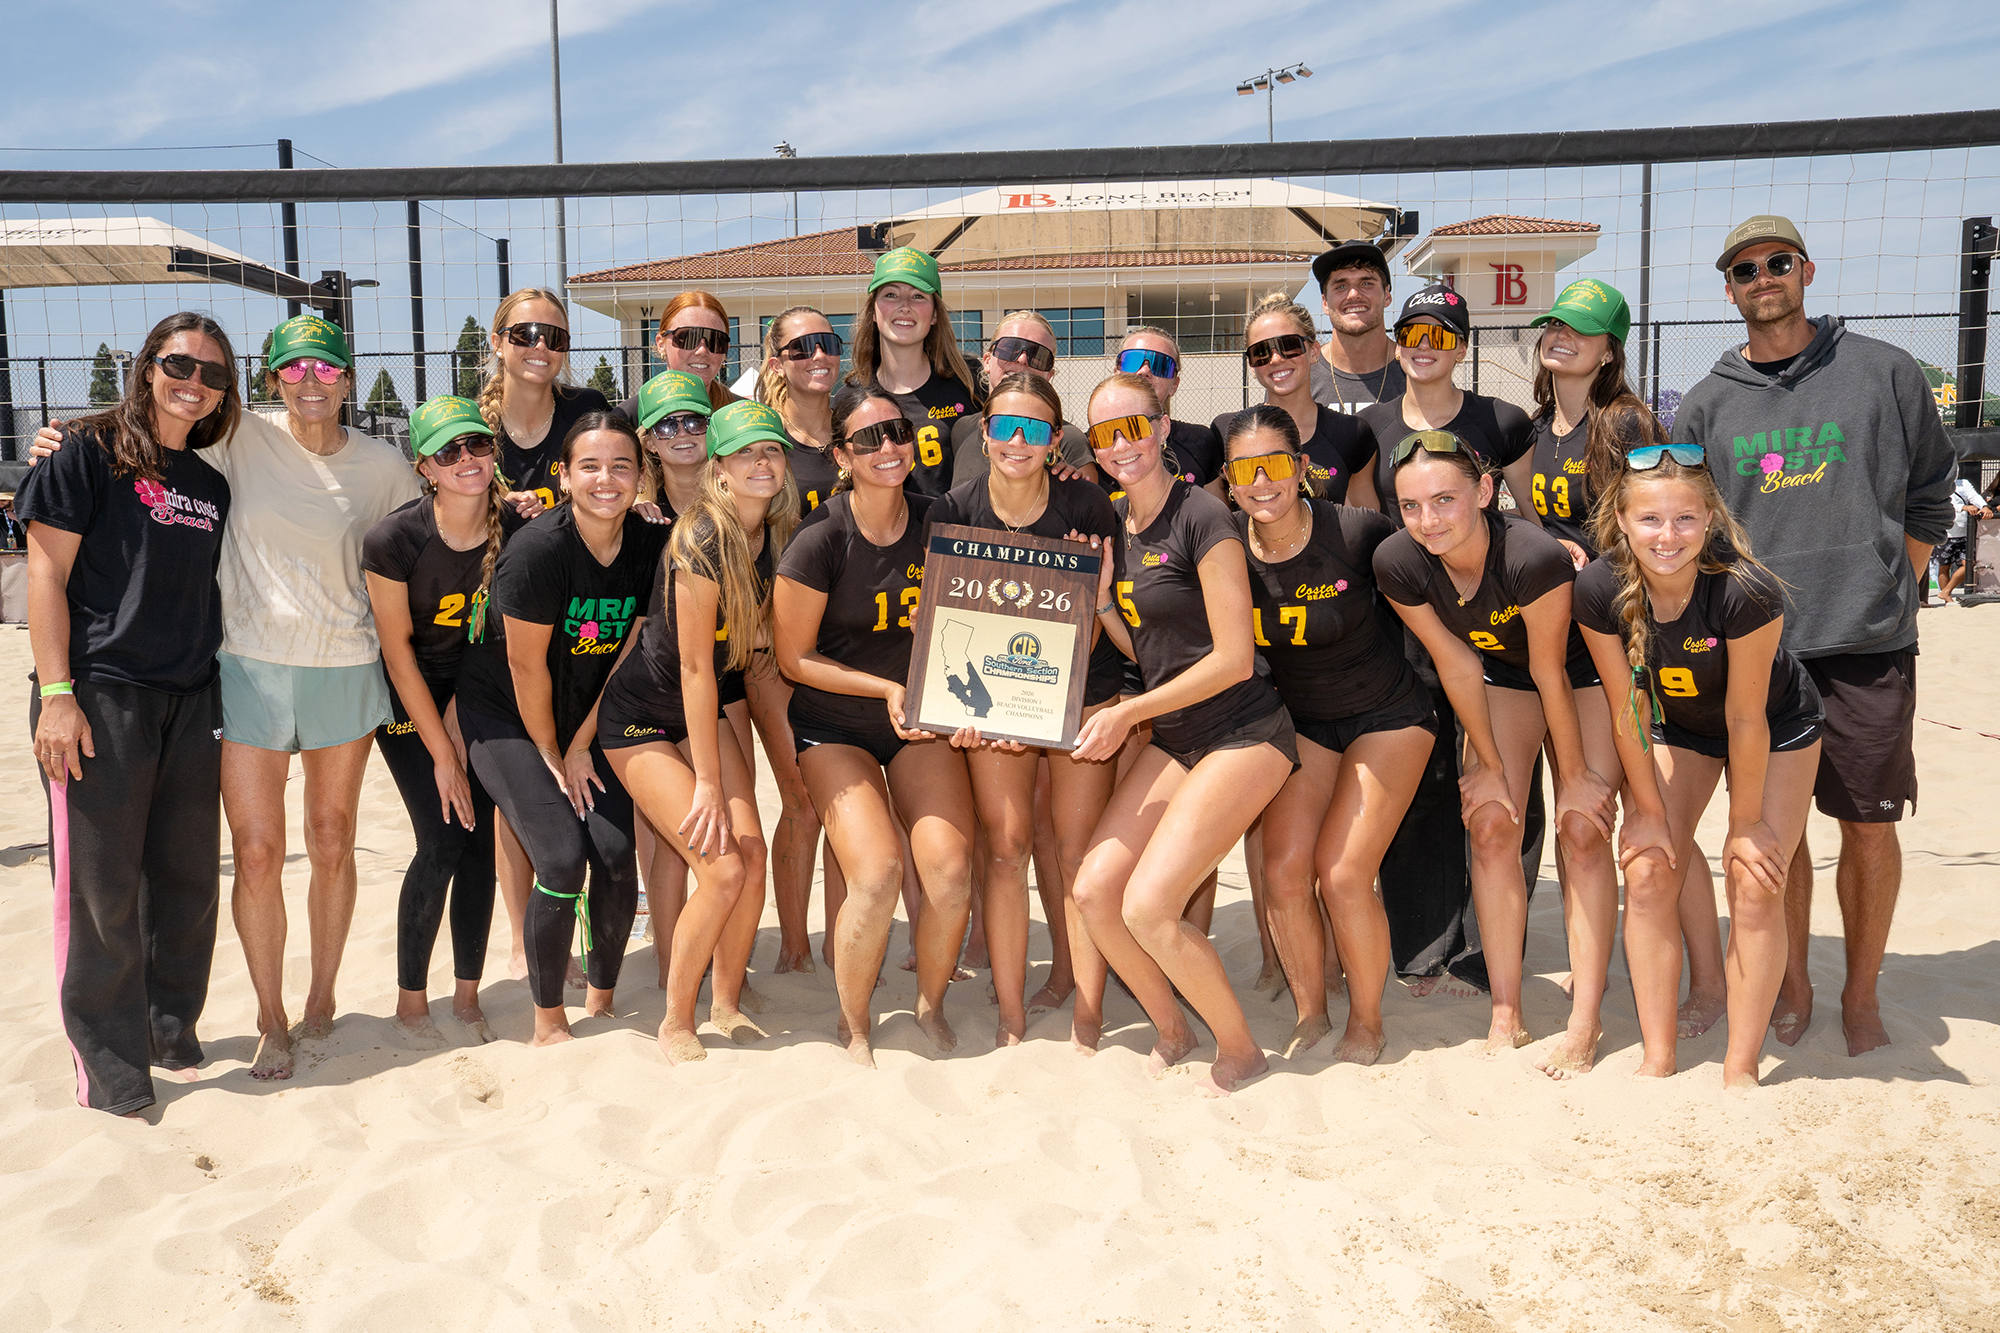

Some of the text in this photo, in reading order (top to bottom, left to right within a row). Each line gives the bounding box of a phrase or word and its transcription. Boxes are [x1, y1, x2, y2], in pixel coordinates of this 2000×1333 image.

[1160, 191, 1250, 199] BEACH
[1408, 291, 1447, 308] Costa
[928, 405, 956, 419] Costa
[1732, 421, 1846, 458] MIRA
[1760, 461, 1828, 494] Beach
[163, 487, 219, 521] mira costa
[1532, 472, 1572, 518] 63
[150, 501, 214, 532] Beach
[952, 540, 1079, 569] CHAMPIONS
[1295, 583, 1336, 599] Costa
[1306, 590, 1339, 601] BEACH
[873, 586, 922, 632] 13
[1490, 604, 1520, 626] Costa
[1252, 605, 1308, 647] 17
[1012, 636, 1037, 657] CIF
[1468, 630, 1506, 651] 2
[985, 656, 1023, 673] Southern
[1026, 666, 1058, 675] Section
[1012, 656, 1034, 667] Ford
[983, 665, 1058, 684] CHAMPIONSHIPS
[1659, 666, 1699, 697] 9
[996, 700, 1055, 715] BEACH VOLLEYBALL
[1011, 695, 1038, 705] DIVISION
[1005, 709, 1044, 720] CHAMPIONS
